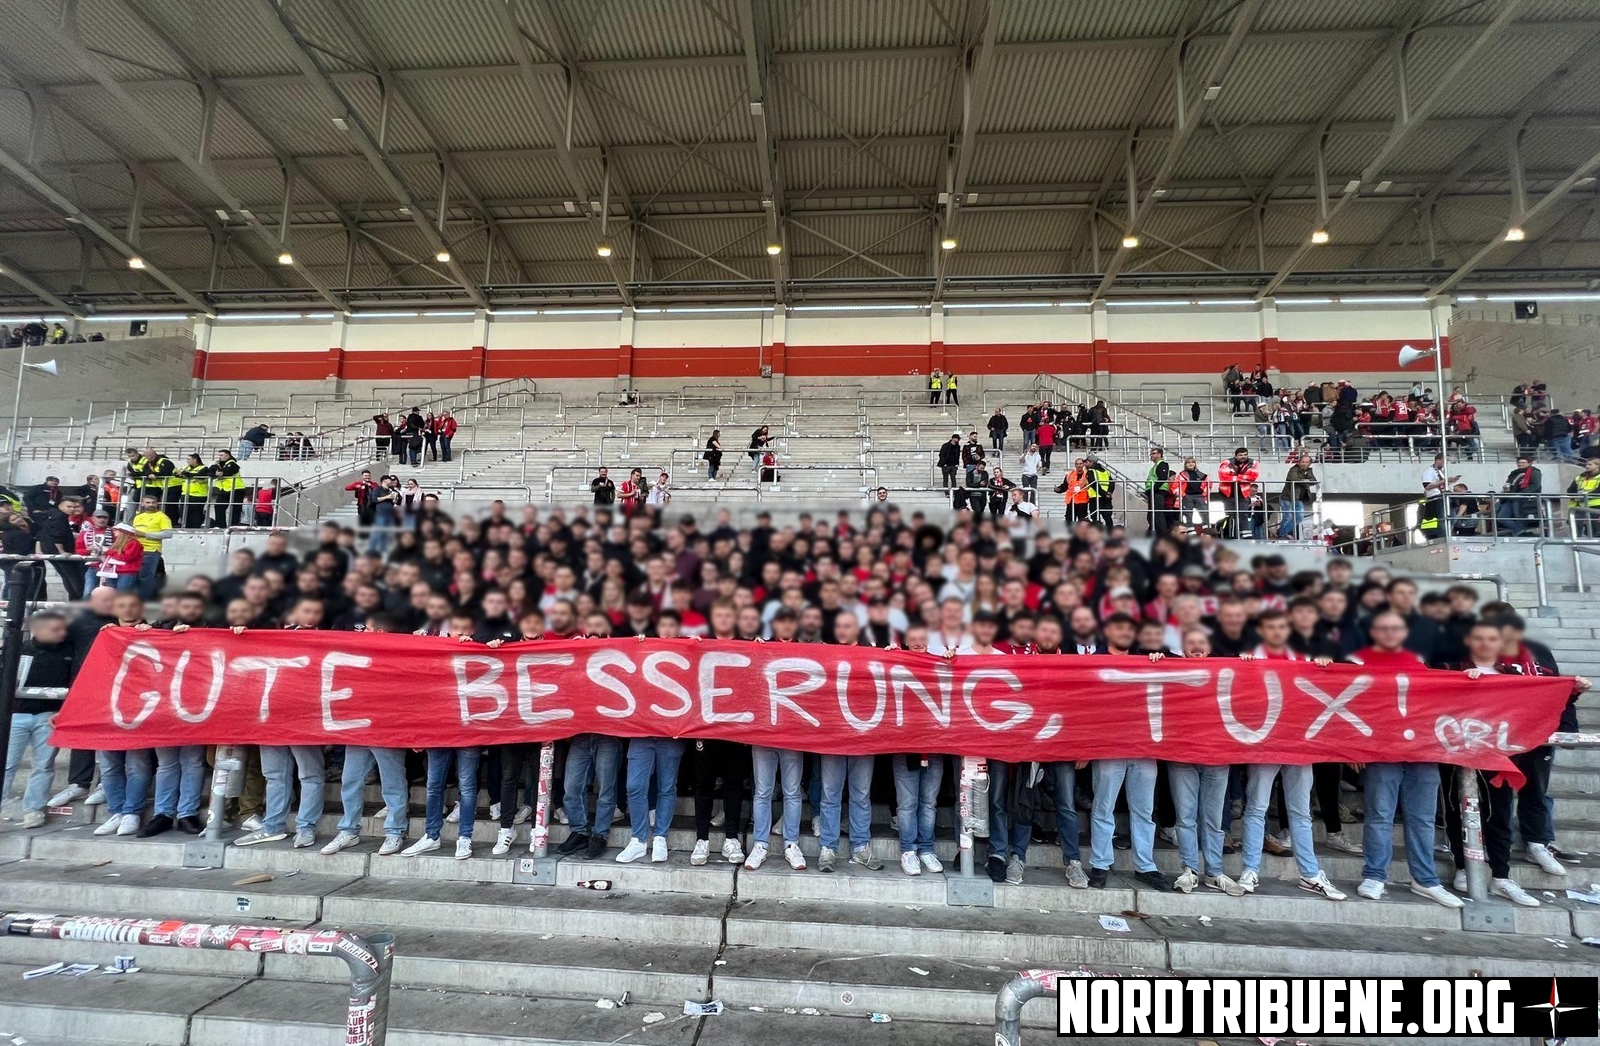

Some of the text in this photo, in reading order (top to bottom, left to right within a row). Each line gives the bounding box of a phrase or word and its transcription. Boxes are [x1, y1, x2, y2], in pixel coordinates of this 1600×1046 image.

[1527, 305, 1535, 314] V
[110, 640, 372, 732] GUTE
[452, 649, 1063, 742] BESSERUNG,
[1097, 667, 1415, 745] TUX!
